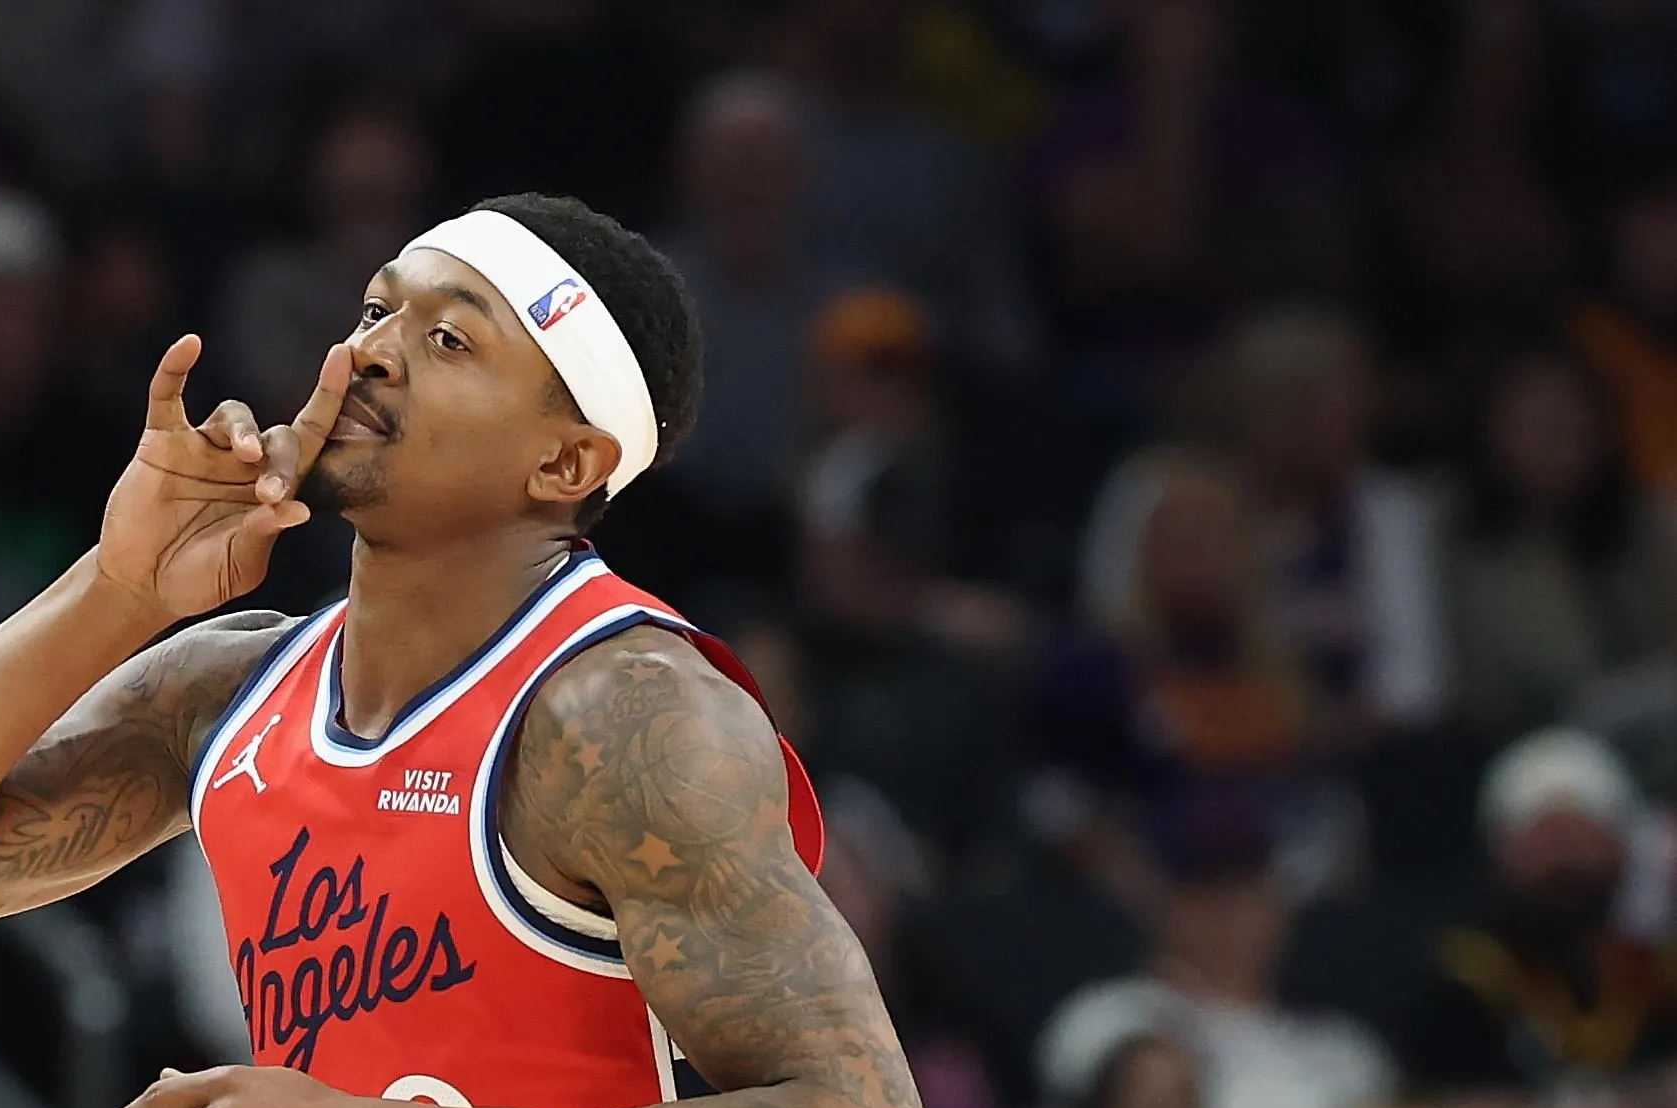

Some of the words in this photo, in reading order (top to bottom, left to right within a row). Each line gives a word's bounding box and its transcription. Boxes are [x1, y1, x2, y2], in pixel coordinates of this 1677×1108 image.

[377, 789, 460, 815] RWANDA
[404, 769, 452, 792] VISIT
[259, 826, 370, 956] Los
[236, 892, 477, 1075] Angeles
